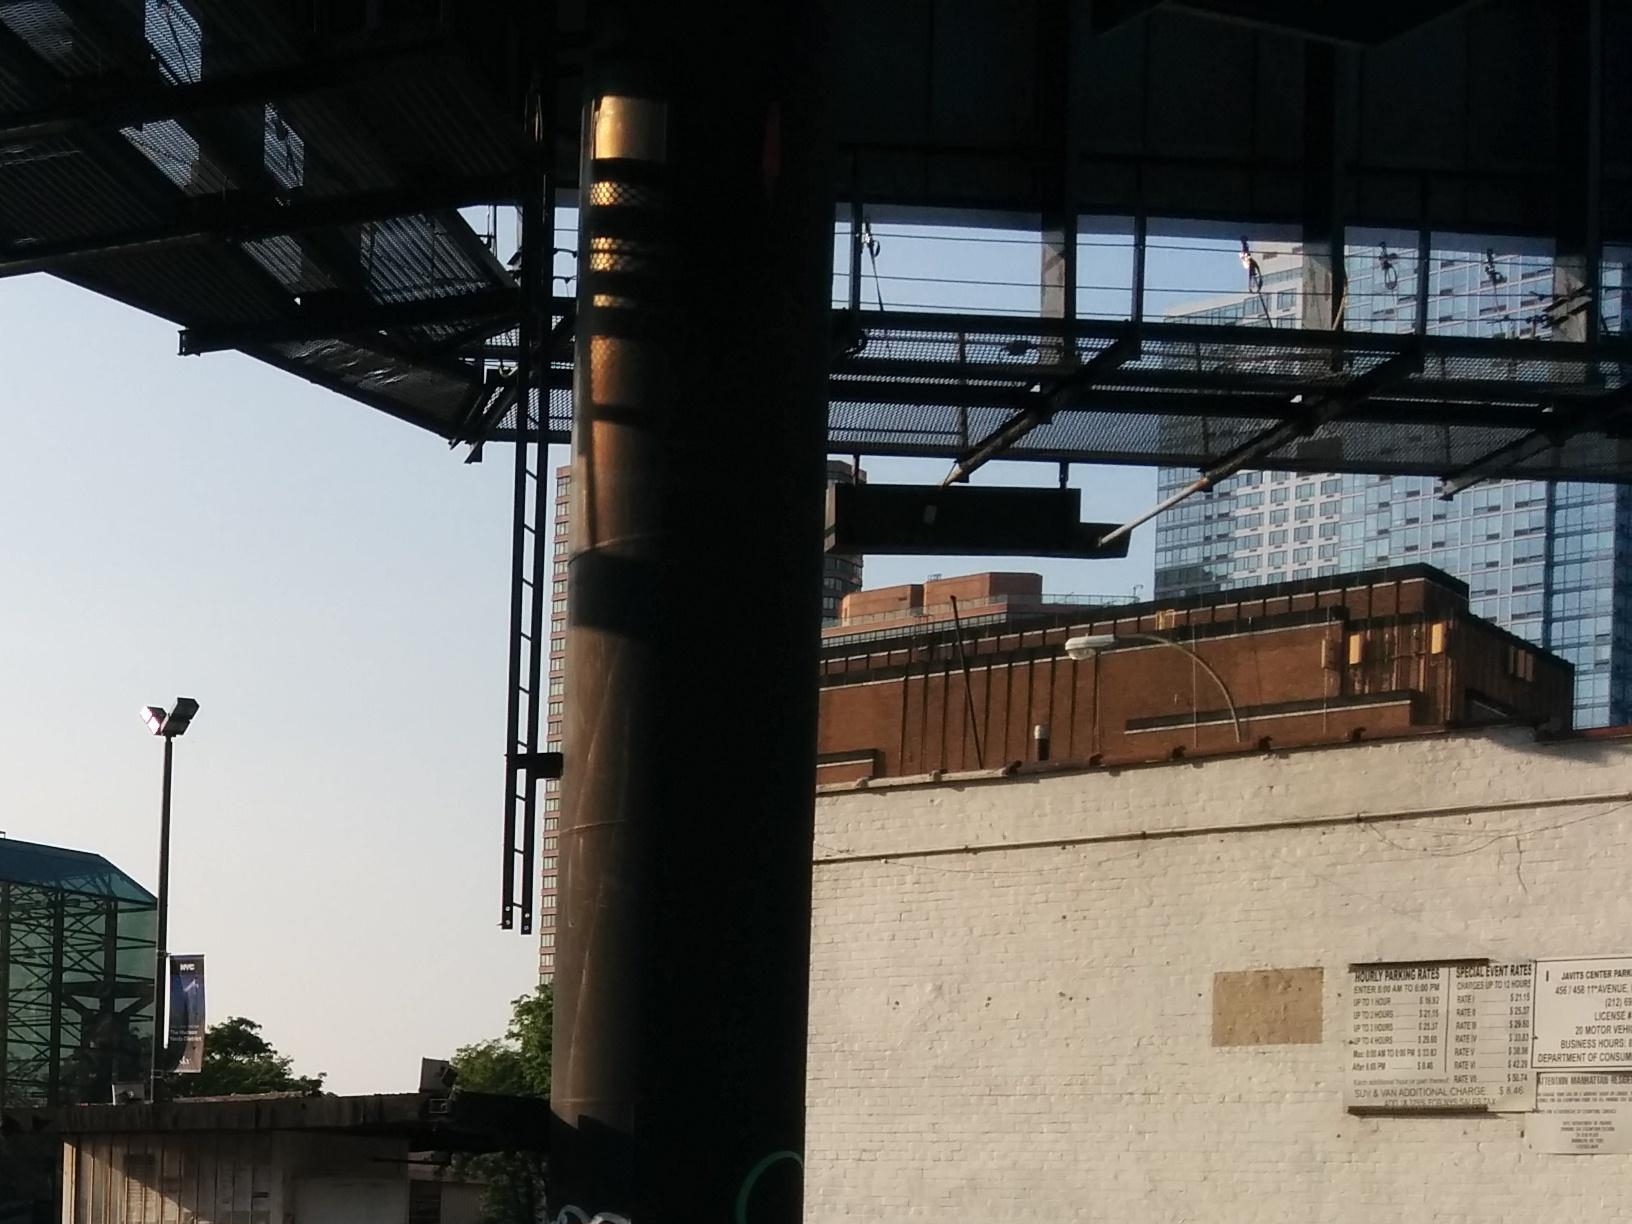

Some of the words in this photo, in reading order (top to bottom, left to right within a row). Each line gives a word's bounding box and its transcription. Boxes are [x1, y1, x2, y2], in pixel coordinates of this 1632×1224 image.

[180, 963, 195, 971] NYC
[1456, 966, 1484, 978] SPECIAL
[1486, 965, 1508, 977] EVENT
[1510, 963, 1532, 976] RATES
[1355, 969, 1382, 982] HOURLY
[1385, 968, 1416, 981] PARKING
[1418, 967, 1440, 980] RATES
[1561, 971, 1584, 981] JAVITS
[1586, 970, 1612, 980] CENTER
[1354, 985, 1376, 993] ENTER
[1405, 984, 1413, 992] TO
[1430, 983, 1440, 991] PM
[1457, 981, 1484, 990] CHARGES
[1485, 981, 1494, 989] UP
[1495, 980, 1503, 988] TO
[1511, 979, 1531, 988] HOURS
[1457, 995, 1472, 1003] RATE
[1605, 997, 1622, 1009] (212)
[1457, 1008, 1471, 1016] RATE
[1594, 1011, 1626, 1021] LICENSE
[1456, 1021, 1471, 1029] RATE
[1585, 1025, 1612, 1035] MOTOR
[1456, 1034, 1470, 1042] RATE
[1560, 1039, 1597, 1049] BUSINESS
[1455, 1048, 1470, 1056] RATE
[1537, 1053, 1586, 1063] DEPARTMENT
[1587, 1052, 1598, 1062] OF
[1455, 1061, 1469, 1069] RATE
[1454, 1075, 1469, 1083] RATE
[1570, 1075, 1609, 1084] MANHATTAN
[1381, 1089, 1397, 1097] VAN
[1399, 1087, 1447, 1097] ADDITIONAL
[1450, 1086, 1486, 1096] CHARGE
